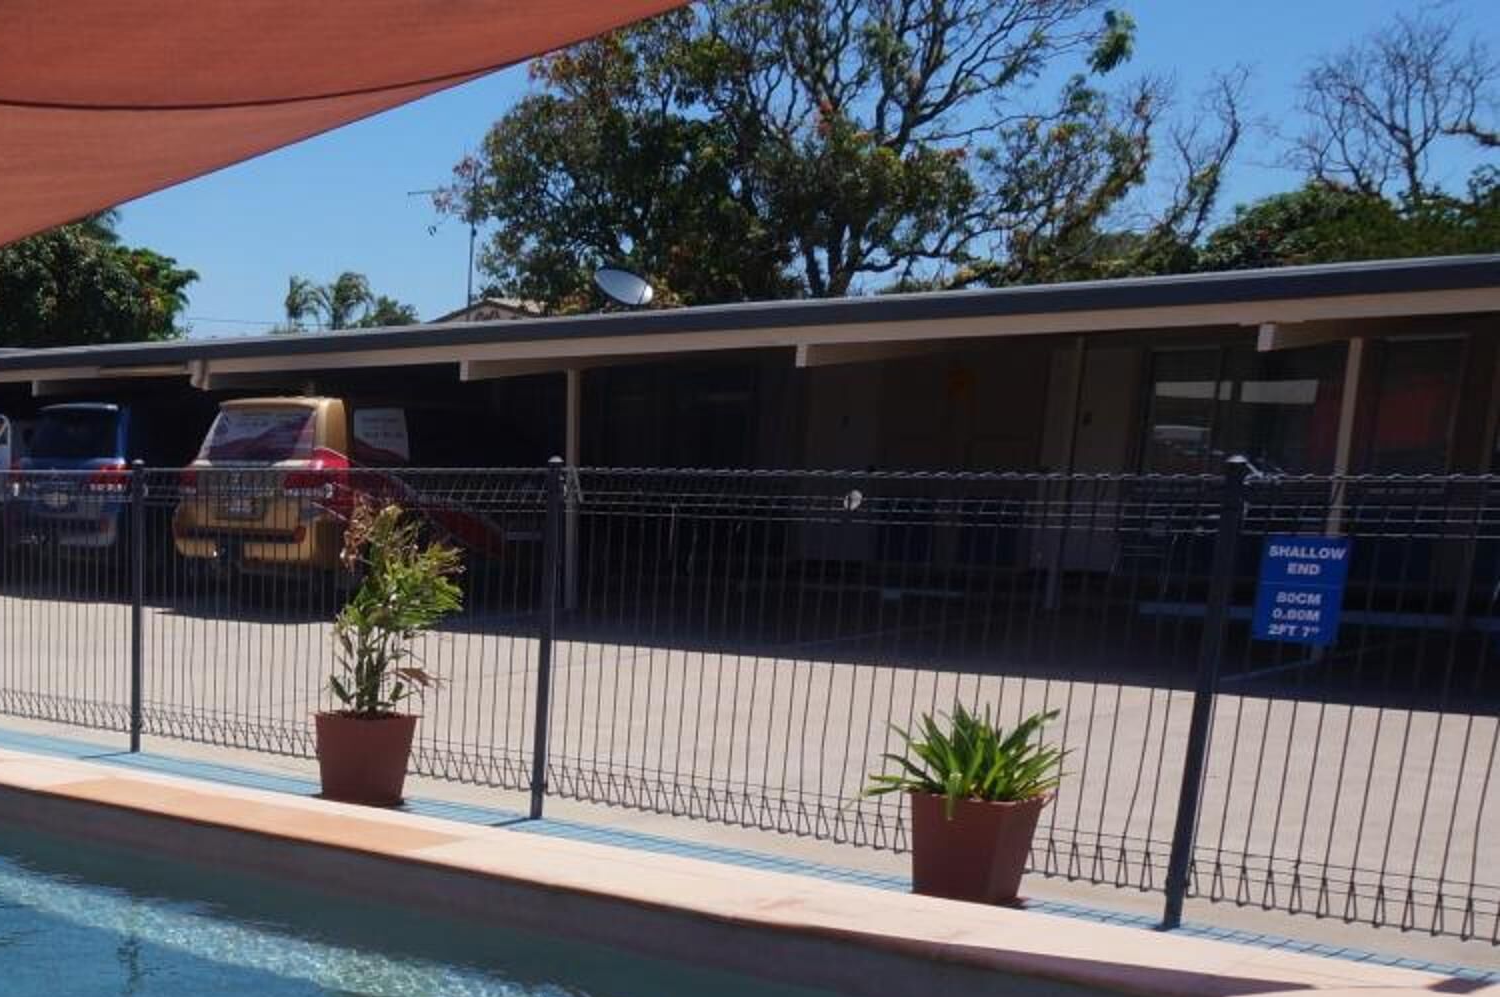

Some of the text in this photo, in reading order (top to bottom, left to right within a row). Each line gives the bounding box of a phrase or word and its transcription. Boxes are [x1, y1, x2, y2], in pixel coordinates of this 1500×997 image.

[1269, 545, 1346, 559] SHALLOW
[1287, 563, 1321, 575] END
[1276, 592, 1322, 605] 80CM
[1272, 608, 1321, 622] 0.80M
[1268, 623, 1296, 636] 2FT
